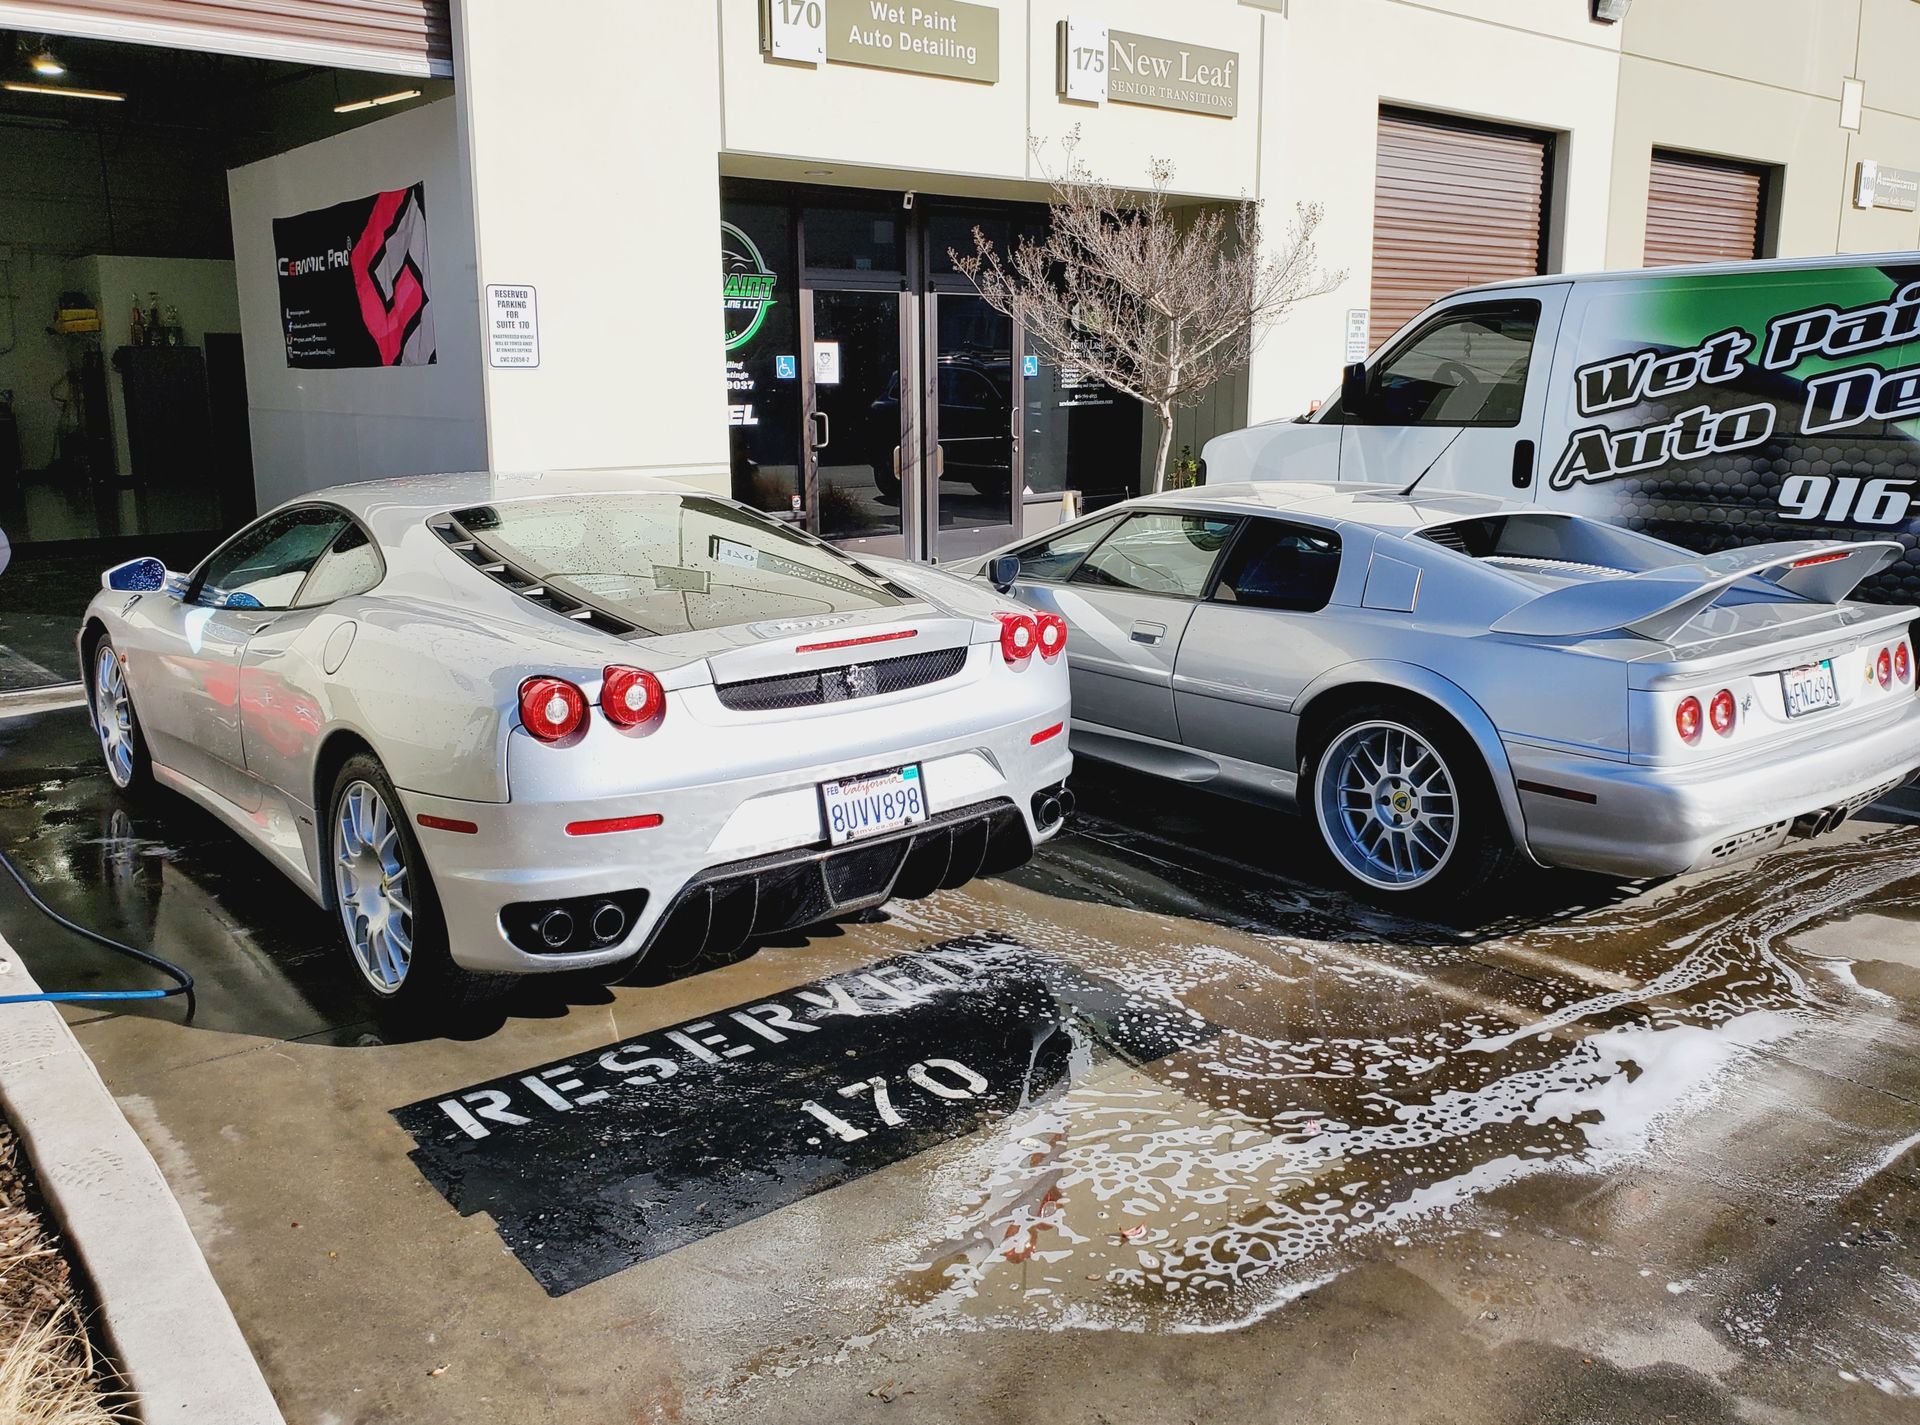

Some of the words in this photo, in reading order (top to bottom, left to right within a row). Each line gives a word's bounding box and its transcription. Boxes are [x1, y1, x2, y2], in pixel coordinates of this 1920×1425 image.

[778, 0, 821, 29] 170
[870, 3, 905, 25] Wet
[911, 8, 957, 32] Paint
[848, 25, 893, 48] Auto
[899, 32, 977, 65] Detailing
[1073, 46, 1105, 73] 175
[1110, 39, 1173, 79] New
[1178, 51, 1235, 89] Leaf
[1111, 80, 1156, 96] SENIOR
[1158, 87, 1233, 108] TRANSITIONS
[494, 289, 528, 299] RESERVED
[723, 273, 777, 300] AINT
[497, 300, 527, 309] PARKING
[506, 310, 519, 319] FOR
[743, 300, 760, 309] LLC
[496, 320, 516, 329] SUITE
[518, 321, 530, 329] 170
[727, 380, 755, 390] 9037
[1576, 329, 1755, 416] Wet
[1551, 400, 1778, 489] Auto
[1789, 675, 1834, 709] 6FNZ696
[826, 785, 839, 796] FEB
[842, 776, 904, 796] California
[831, 787, 920, 833] 8UVV898
[798, 1056, 990, 1143] 170
